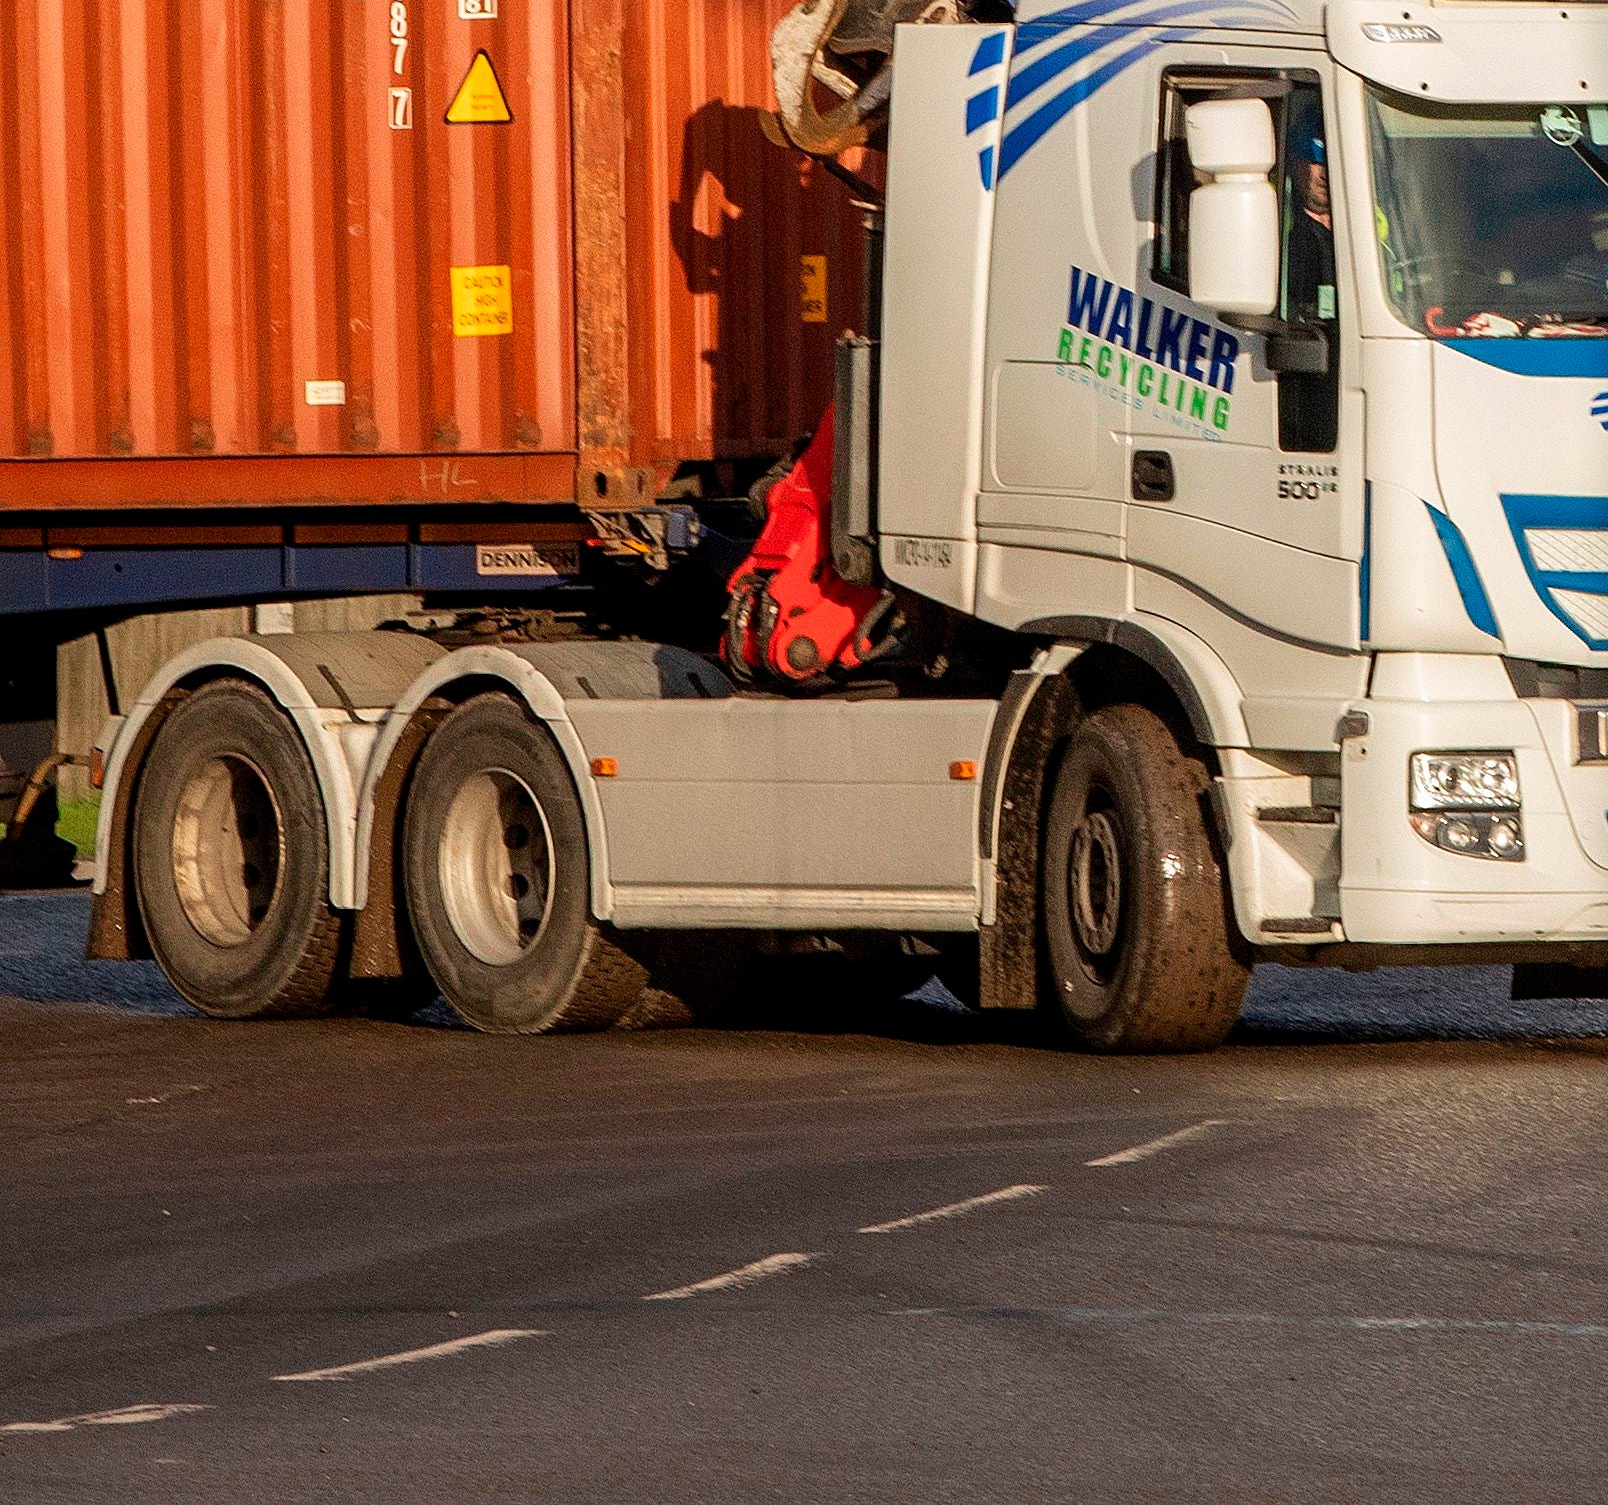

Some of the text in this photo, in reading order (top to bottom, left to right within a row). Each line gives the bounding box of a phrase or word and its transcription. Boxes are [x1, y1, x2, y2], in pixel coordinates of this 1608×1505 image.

[389, 89, 410, 128] 7
[1067, 263, 1241, 396] WALKER
[1056, 326, 1234, 432] RECYCLING
[480, 549, 578, 569] DENNISON
